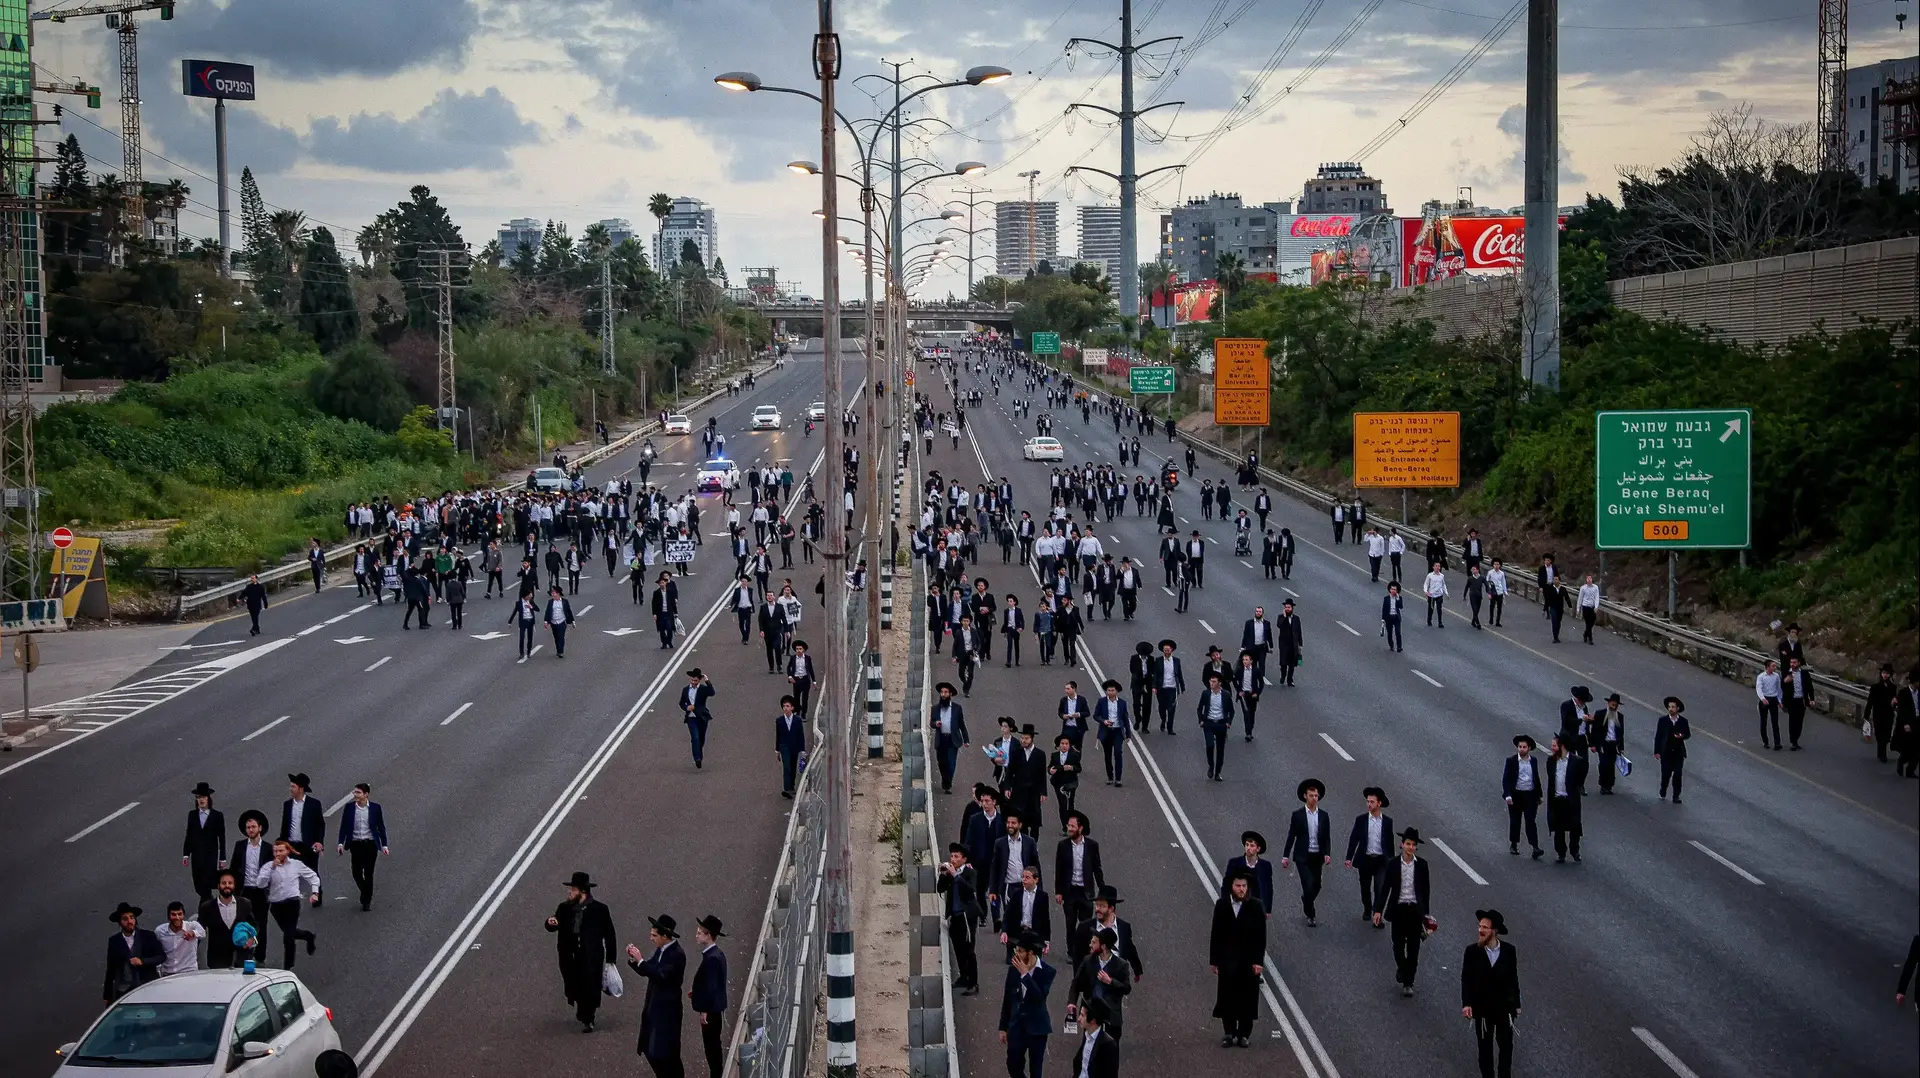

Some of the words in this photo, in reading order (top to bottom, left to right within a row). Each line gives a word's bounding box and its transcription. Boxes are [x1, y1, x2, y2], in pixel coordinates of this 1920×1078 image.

[216, 79, 252, 94] הפניקס
[1622, 421, 1668, 433] שמואל
[1676, 421, 1711, 432] גבעת
[1638, 438, 1664, 451] ברק
[1672, 438, 1692, 448] בני
[1639, 455, 1666, 468] براك
[1674, 456, 1692, 469] بني
[1622, 488, 1659, 498] Bene
[1666, 488, 1710, 500] Beraq
[1608, 504, 1651, 514] Giv'at
[1658, 503, 1724, 514] Shemu'el
[1653, 525, 1679, 535] 500
